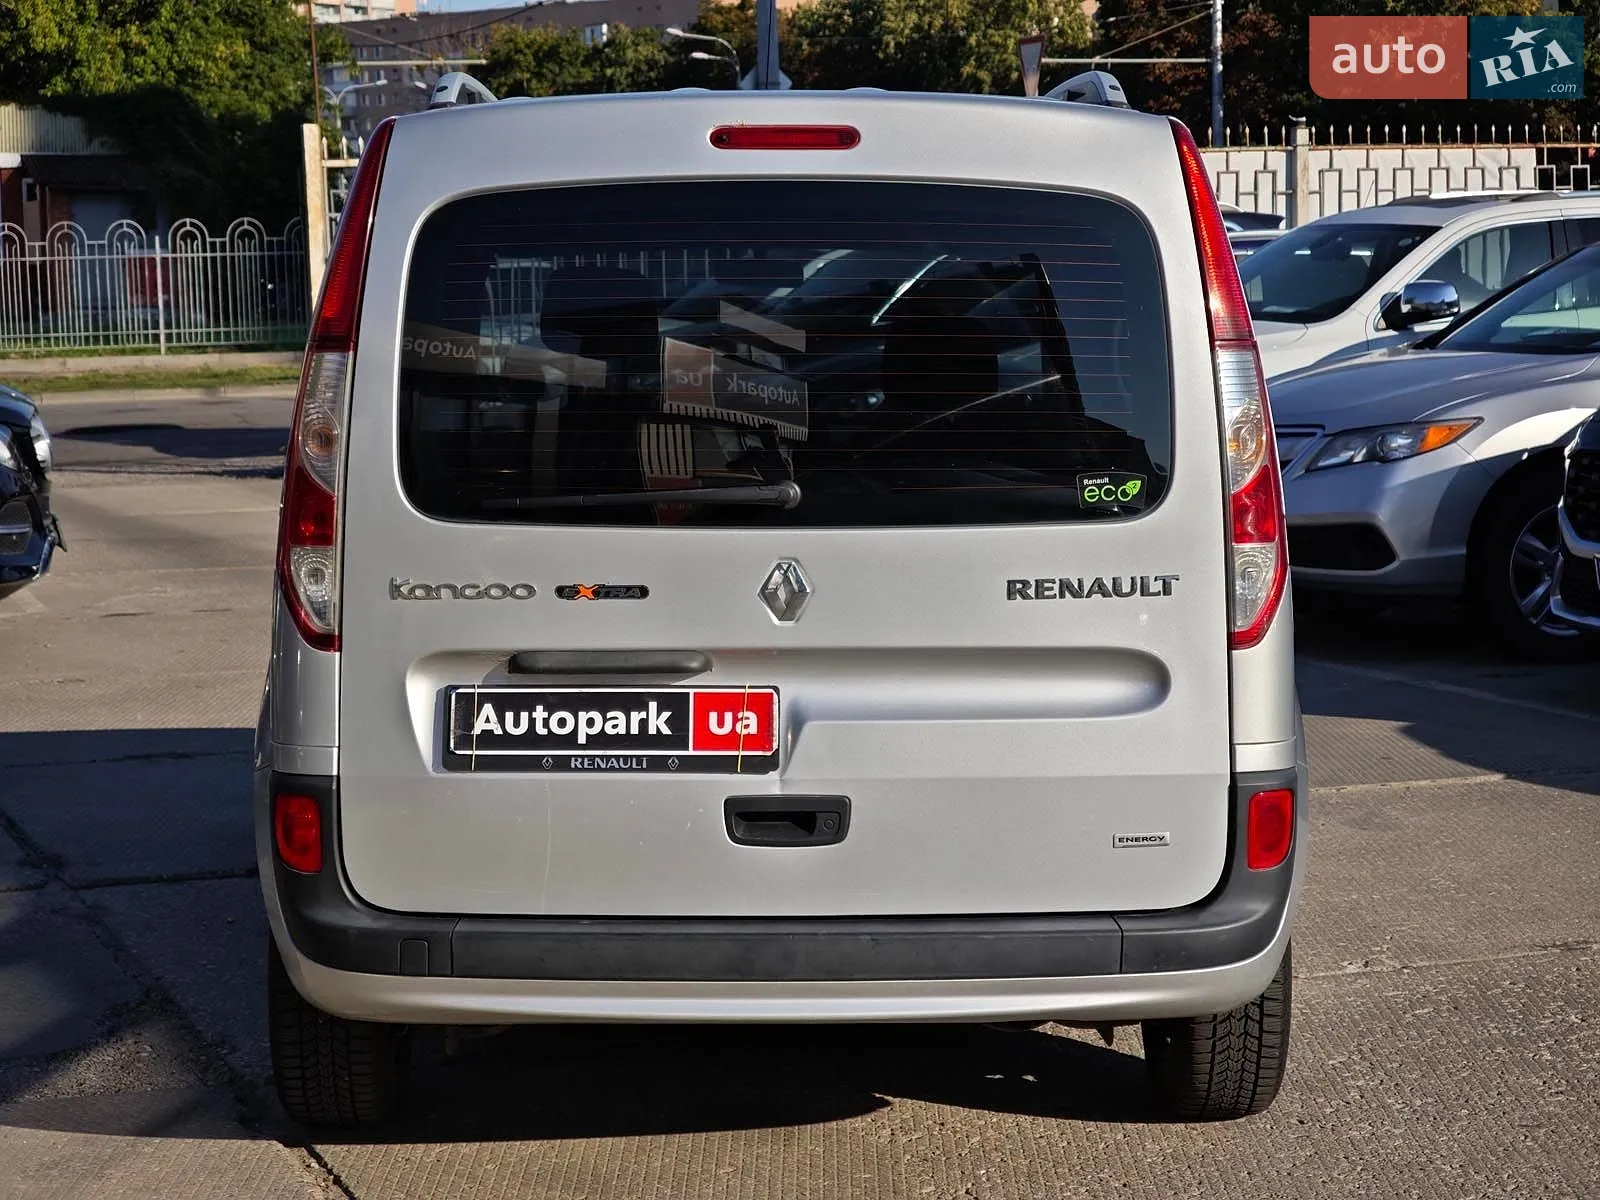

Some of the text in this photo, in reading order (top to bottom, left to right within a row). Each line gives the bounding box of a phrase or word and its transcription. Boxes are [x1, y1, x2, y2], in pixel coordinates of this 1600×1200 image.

[1083, 476, 1109, 486] Renault
[1006, 575, 1180, 600] RENAULT
[473, 702, 758, 744] Autopark ua
[571, 757, 647, 769] RENAULT
[1118, 835, 1165, 843] ENERGY
